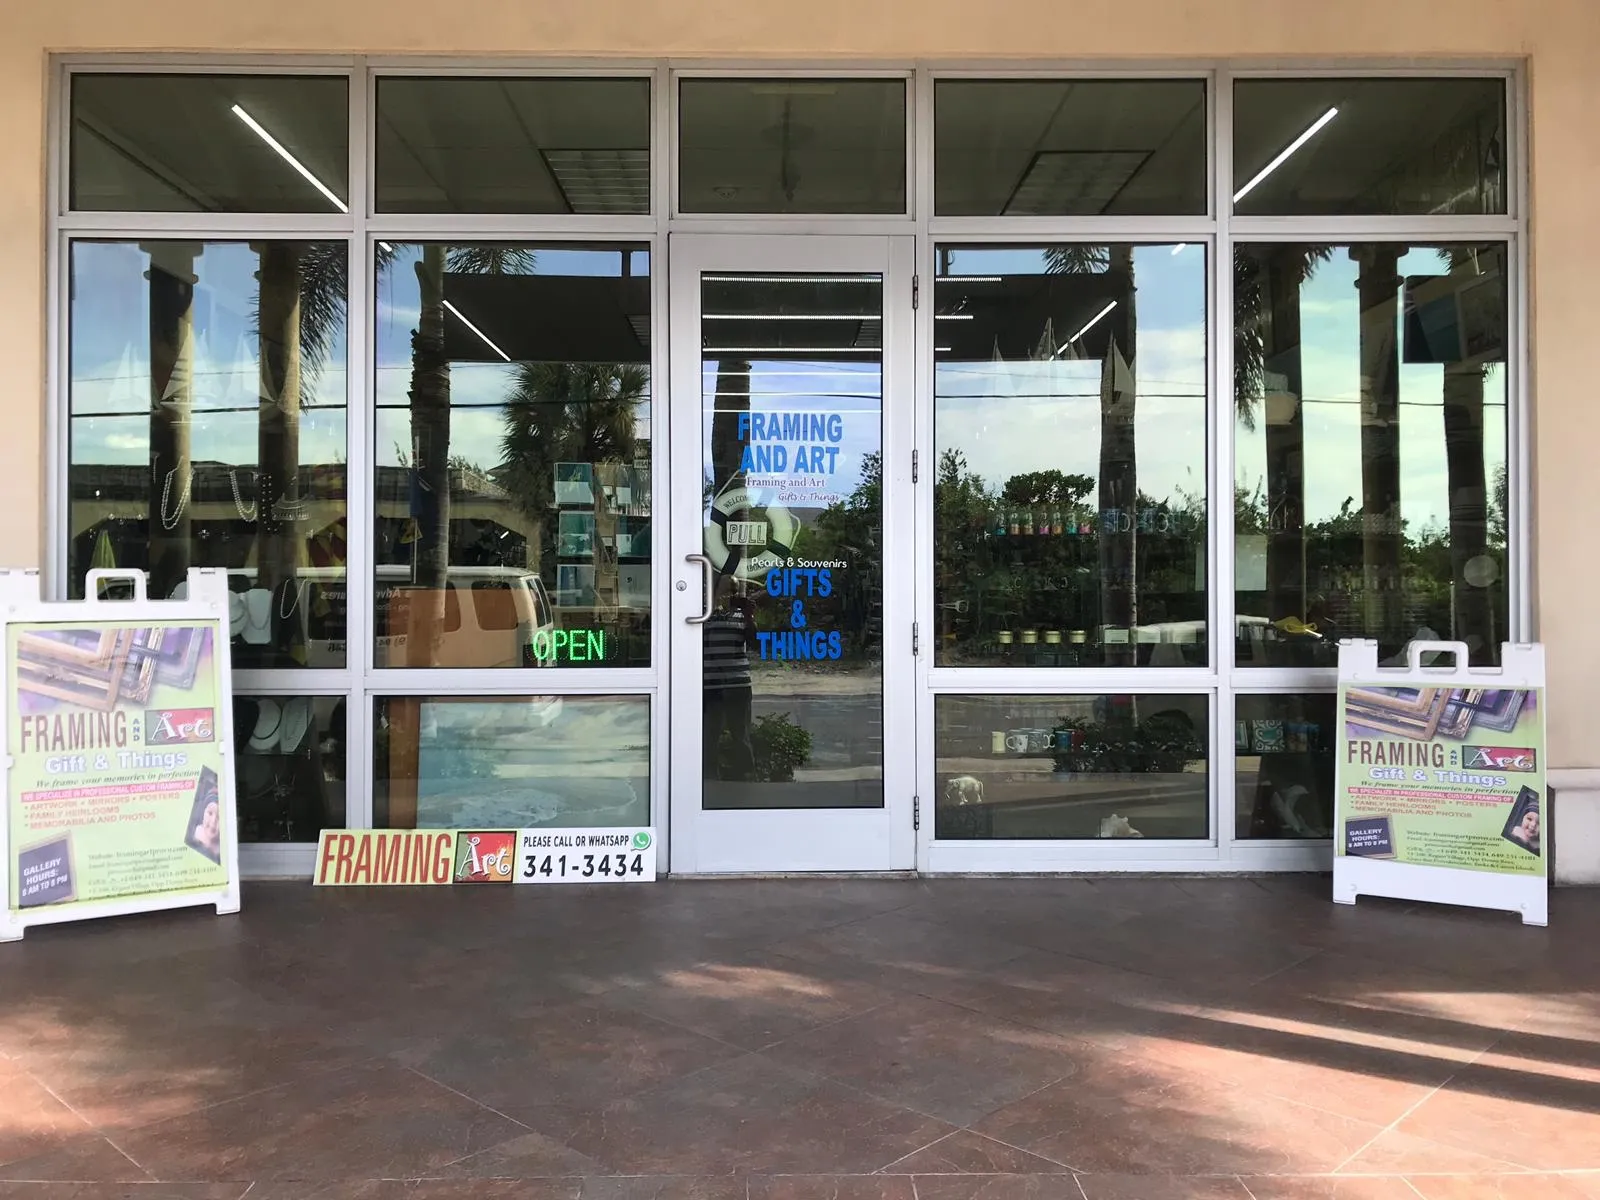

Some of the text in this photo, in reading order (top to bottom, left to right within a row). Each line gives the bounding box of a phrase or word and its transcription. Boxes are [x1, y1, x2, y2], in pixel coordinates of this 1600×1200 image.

[738, 412, 843, 442] FRAMING
[740, 445, 840, 474] AND ART
[747, 476, 825, 490] Framing and Art
[779, 493, 798, 503] Gifts
[810, 493, 840, 503] Things
[728, 524, 766, 544] PULL
[751, 557, 785, 568] Pearls
[787, 557, 795, 567] &
[797, 558, 848, 569] Souvenirs
[766, 569, 833, 597] GIFTS
[790, 600, 807, 628] &
[532, 630, 604, 661] OPEN
[756, 631, 843, 661] THINGS
[21, 710, 212, 753] FRAMING AND Art
[45, 750, 188, 774] Gift & Things
[1348, 740, 1445, 768] FRAMING
[1465, 748, 1534, 771] Art
[37, 779, 49, 788] We
[52, 779, 79, 788] frame
[103, 773, 146, 783] memories
[158, 769, 201, 780] perfection
[1369, 767, 1508, 788] Gift & Things
[1475, 787, 1520, 795] perfection
[97, 814, 118, 824] AND
[119, 811, 156, 822] PHOTOS
[1435, 810, 1472, 818] PHOTOS
[523, 835, 630, 848] PLEASE CALL OR WHATSAPP
[1350, 828, 1382, 836] GALLERY
[24, 857, 62, 876] GALLERY
[320, 833, 511, 884] FRAMING Art
[522, 854, 644, 878] 341-3434
[26, 868, 59, 885] HOURS:
[28, 883, 40, 895] AM
[41, 880, 50, 890] TO
[57, 873, 68, 885] PM
